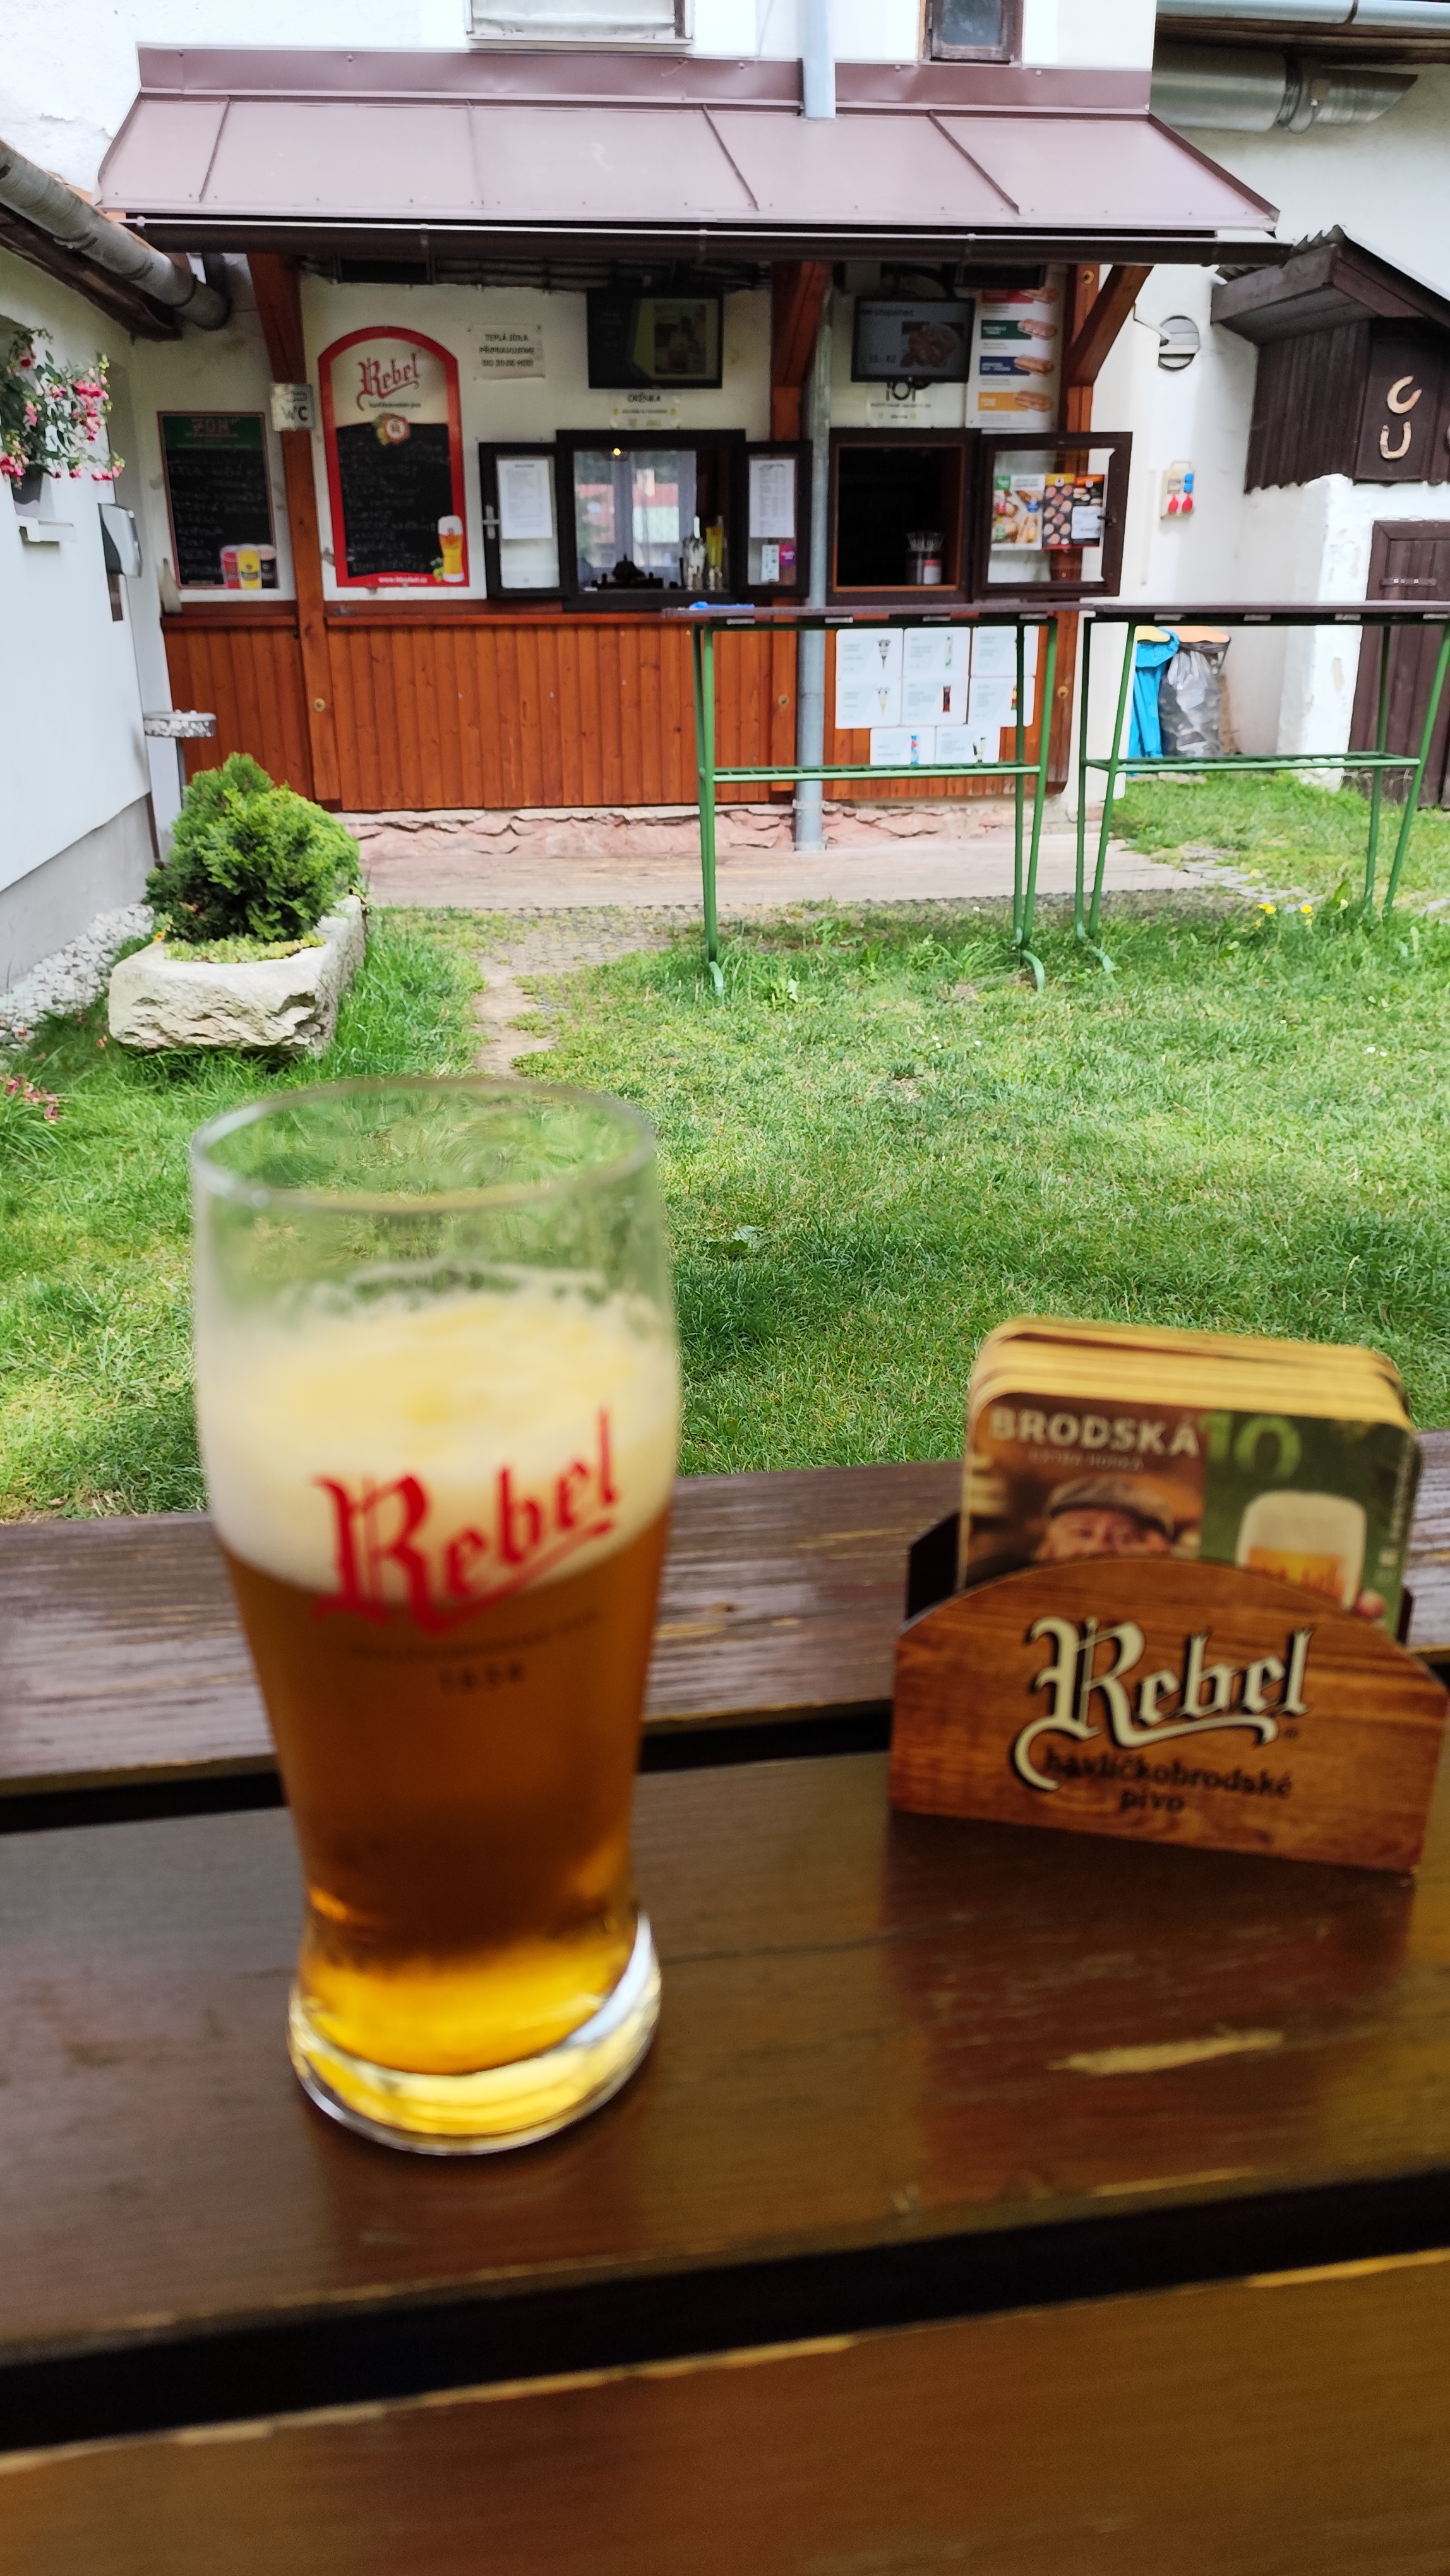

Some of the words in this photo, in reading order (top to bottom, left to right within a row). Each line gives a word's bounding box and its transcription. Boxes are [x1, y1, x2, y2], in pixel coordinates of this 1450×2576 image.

[484, 333, 506, 342] TEPLÁ
[356, 352, 422, 412] Rebel
[280, 405, 308, 422] WC
[990, 1405, 1200, 1457] BRODSKÁ
[1199, 1409, 1302, 1479] 10
[307, 1402, 620, 1637] Rebel
[1010, 1615, 1316, 1792] Rebel
[1045, 1746, 1293, 1799] havlíčkobrodské
[1119, 1787, 1185, 1814] pivo
